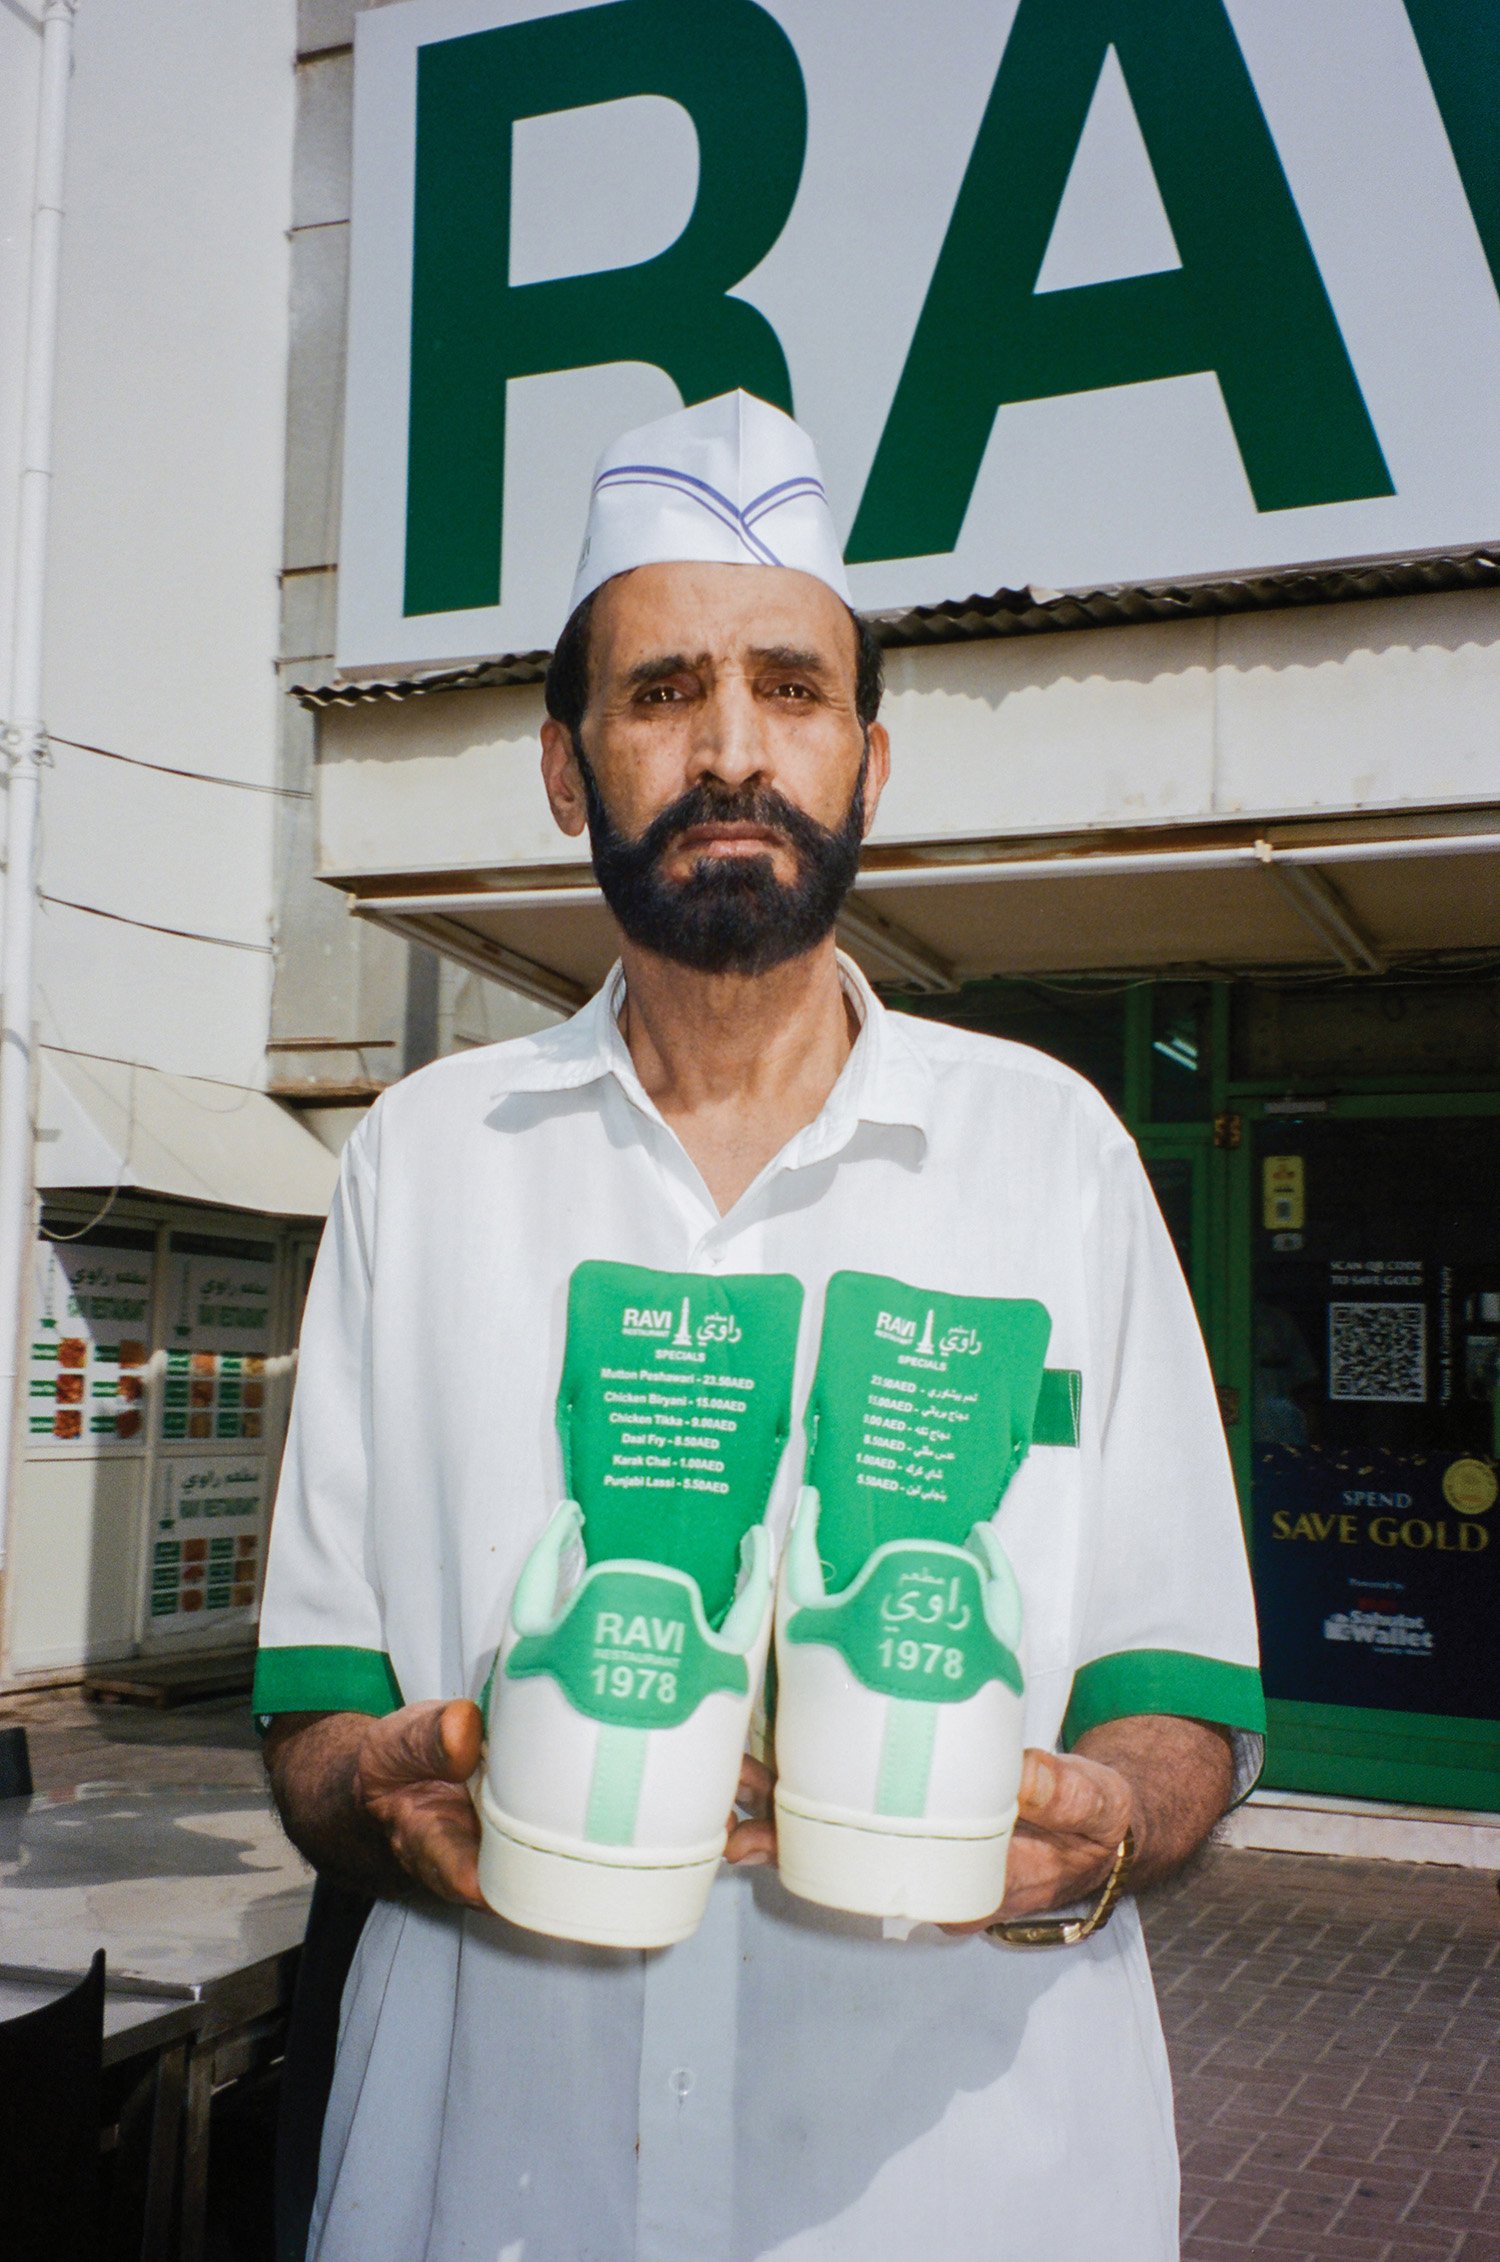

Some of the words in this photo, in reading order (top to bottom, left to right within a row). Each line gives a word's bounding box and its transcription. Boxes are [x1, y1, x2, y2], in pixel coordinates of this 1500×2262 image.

[623, 1308, 672, 1329] RAVI
[876, 1310, 917, 1338] RAVI
[655, 1349, 706, 1362] SPECIALS
[897, 1354, 947, 1372] SPECIALS
[601, 1368, 638, 1381] Mutton
[703, 1374, 755, 1390] 23.50AED
[604, 1391, 647, 1405] Chicken
[649, 1393, 687, 1407] Biryani
[609, 1412, 652, 1425] Chicken
[654, 1414, 683, 1427] Tikka
[621, 1433, 646, 1444] Daal
[647, 1433, 666, 1448] Fry
[612, 1454, 644, 1466] Karak
[646, 1455, 671, 1467] Chai
[604, 1475, 644, 1489] Punjabi
[646, 1476, 675, 1488] Lassi
[1342, 1490, 1413, 1509] SPEND
[1272, 1510, 1358, 1545] SAVE
[1368, 1516, 1489, 1552] GOLD
[899, 1567, 946, 1586] مطعم
[881, 1577, 970, 1633] راوي
[593, 1611, 686, 1654] RAVI
[878, 1638, 965, 1680] 1978
[591, 1663, 677, 1705] 1978
